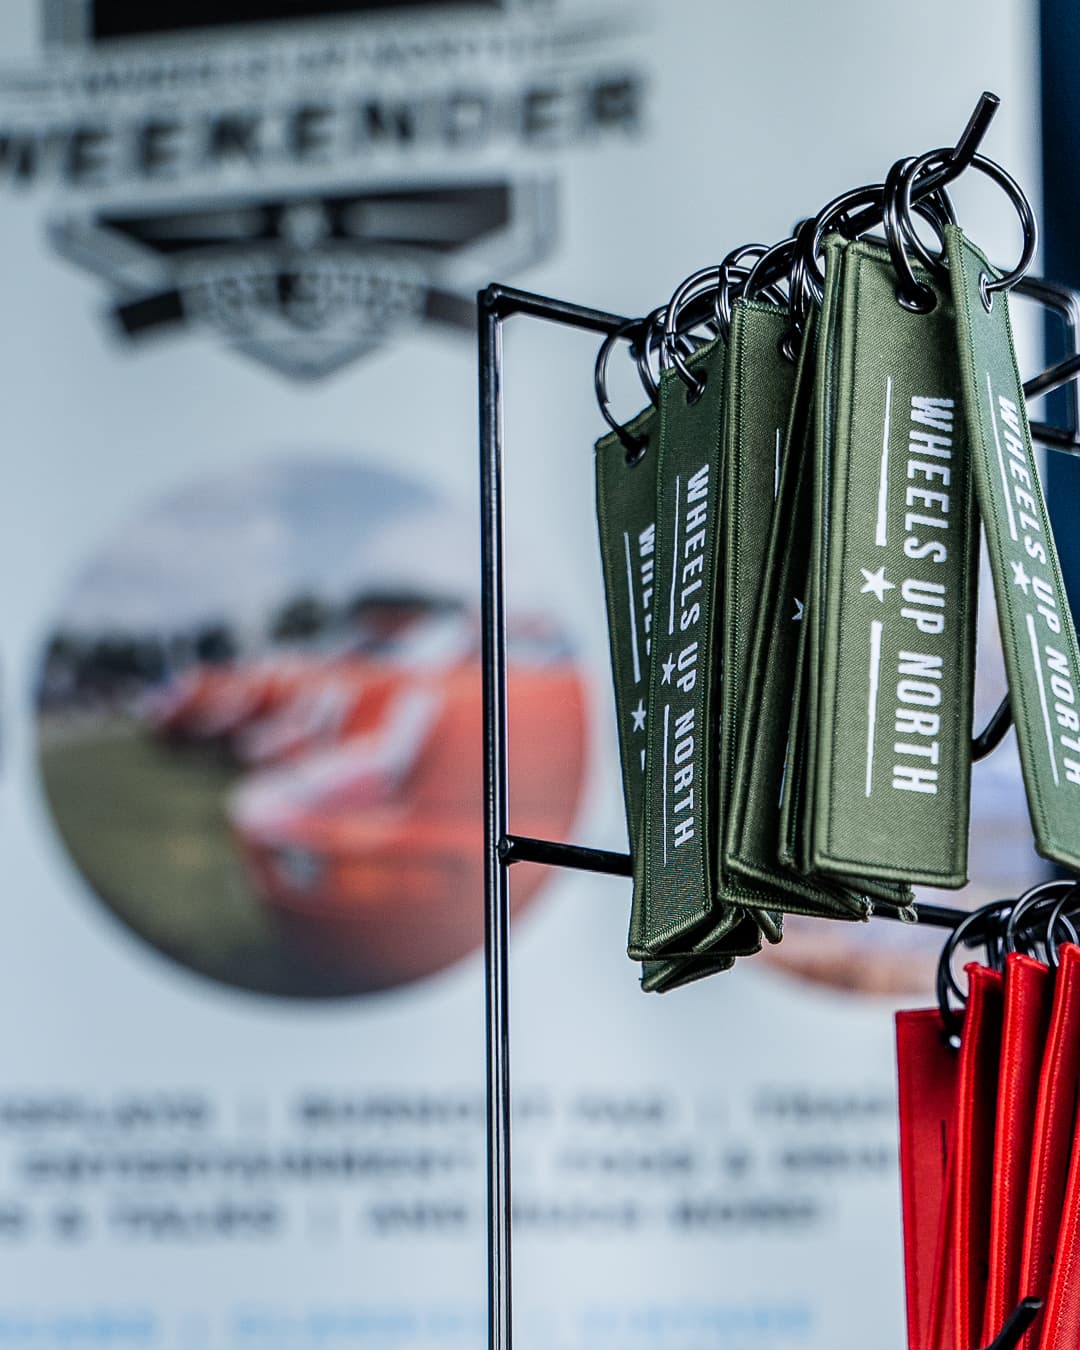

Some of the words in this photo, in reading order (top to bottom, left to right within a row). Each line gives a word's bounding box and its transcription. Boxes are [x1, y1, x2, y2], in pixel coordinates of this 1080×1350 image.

[680, 464, 709, 631] WHEELS
[904, 396, 953, 562] WHEELS
[998, 396, 1046, 565] WHEELS
[1031, 577, 1061, 634] UP
[677, 642, 698, 692] UP
[900, 578, 945, 633] UP
[672, 708, 695, 848] NORTH
[891, 650, 942, 794] NORTH
